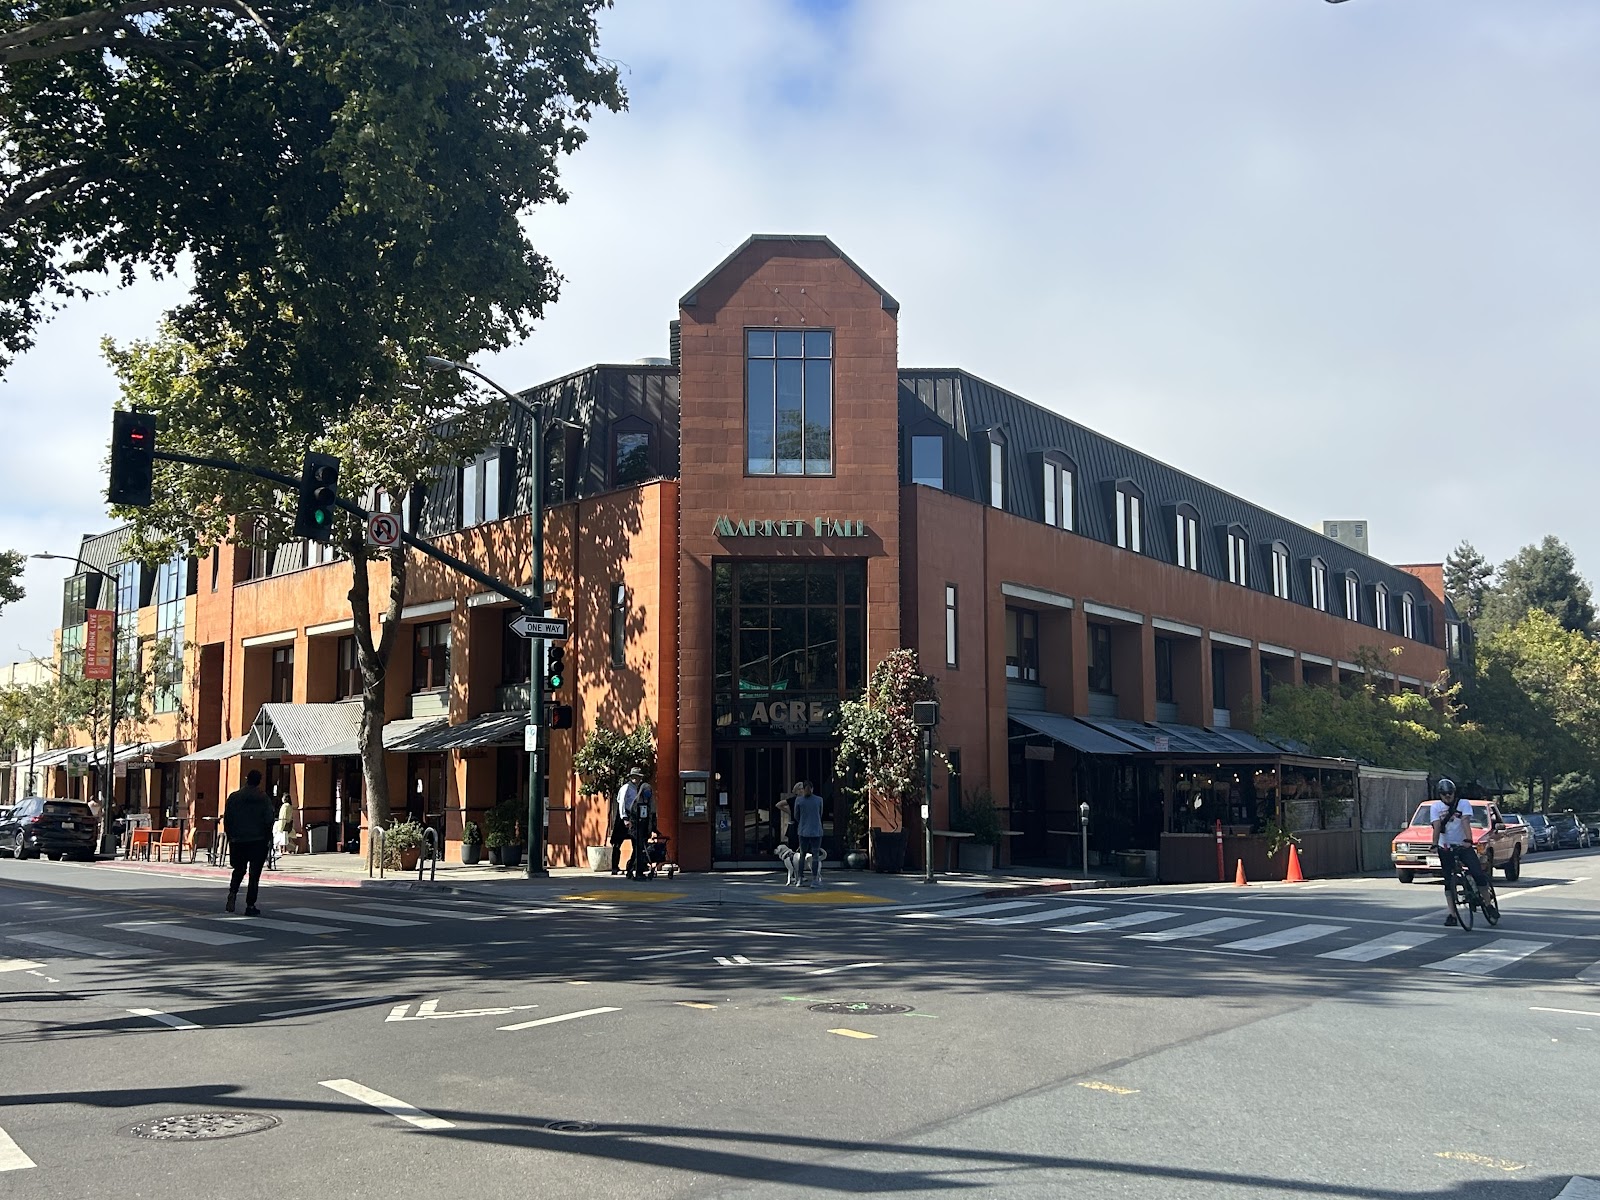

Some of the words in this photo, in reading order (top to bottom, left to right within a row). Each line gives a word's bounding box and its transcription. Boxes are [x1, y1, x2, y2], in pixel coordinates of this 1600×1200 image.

[711, 514, 806, 537] MARKET
[814, 516, 869, 537] HALL
[89, 613, 97, 629] LIVE
[527, 623, 542, 631] ONE
[545, 624, 560, 632] WAY
[88, 630, 96, 651] DRINK
[87, 653, 95, 666] EAT
[751, 701, 823, 722] ACRE
